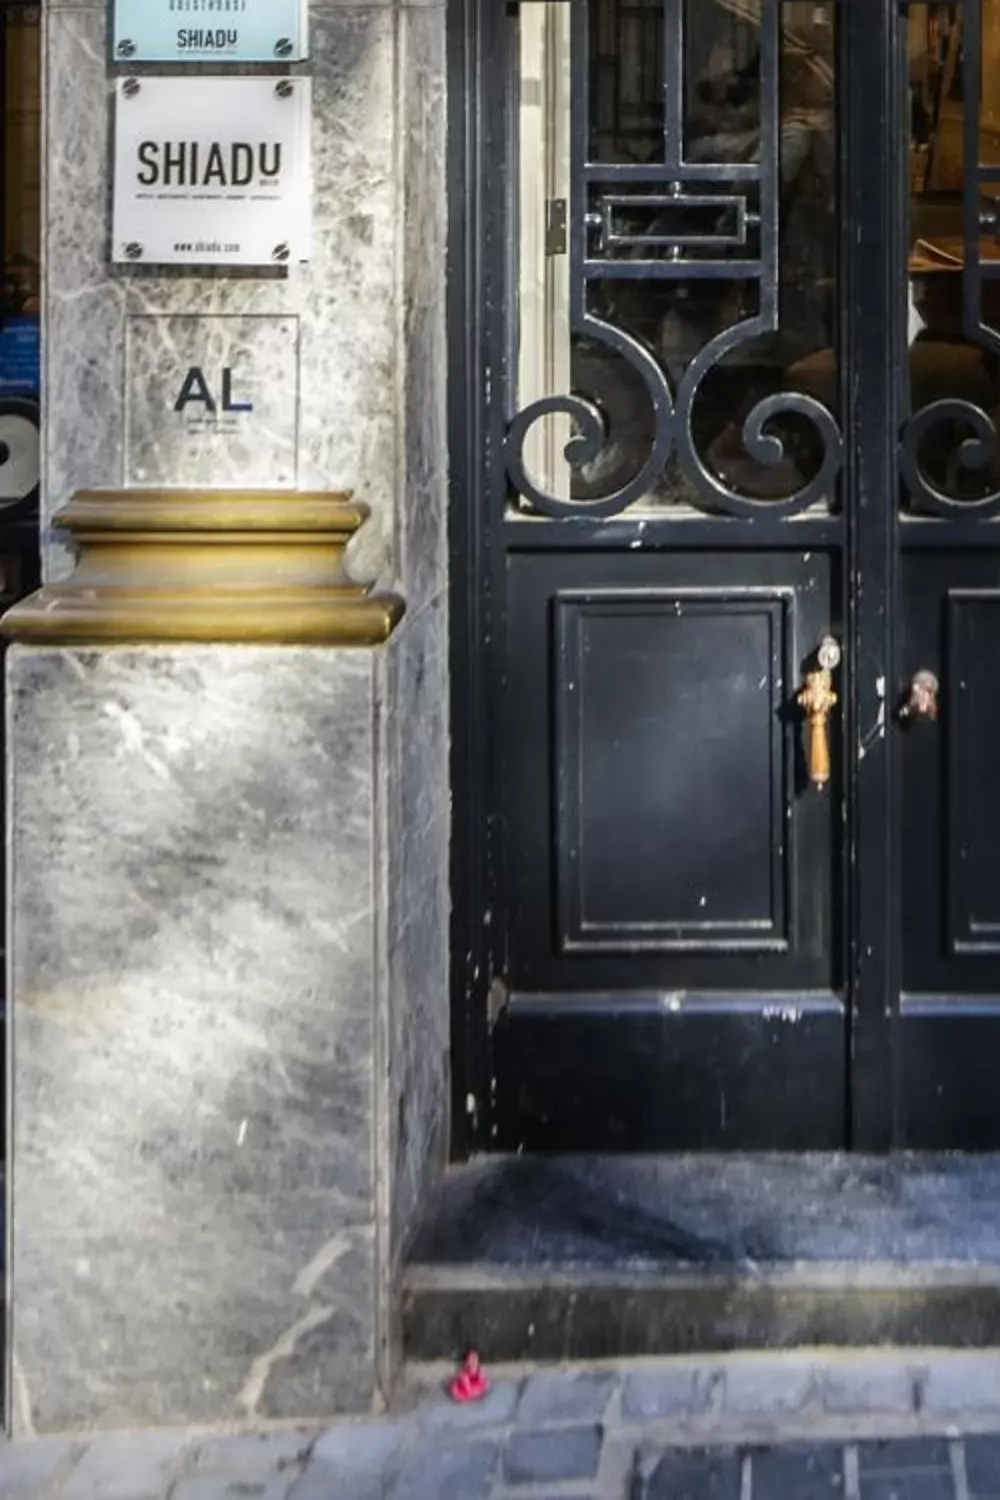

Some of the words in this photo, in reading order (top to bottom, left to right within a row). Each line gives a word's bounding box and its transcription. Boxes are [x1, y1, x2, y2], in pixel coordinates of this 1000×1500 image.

[177, 29, 238, 48] SHIADU
[137, 141, 281, 186] SHIADU
[174, 367, 253, 411] AL
